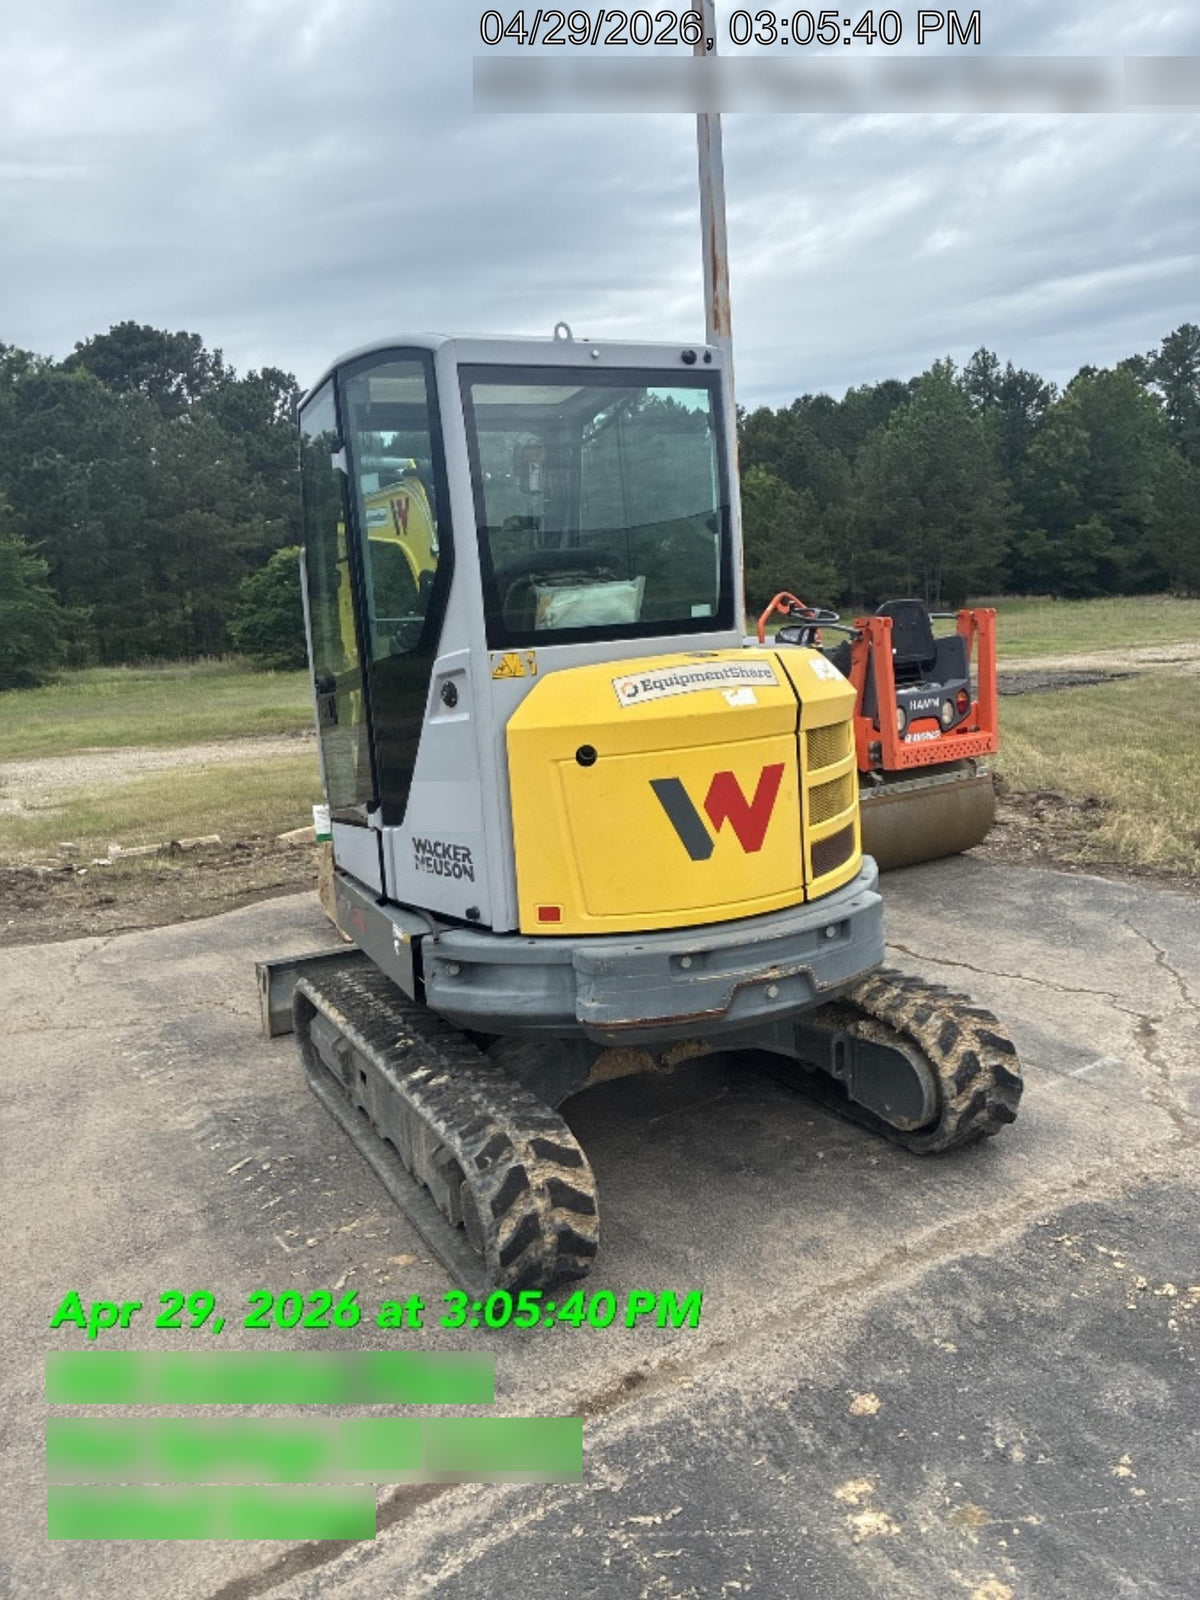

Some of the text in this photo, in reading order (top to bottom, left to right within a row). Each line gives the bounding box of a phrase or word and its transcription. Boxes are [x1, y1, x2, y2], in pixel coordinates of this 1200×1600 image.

[640, 667, 773, 692] EquipmentShare
[412, 837, 473, 864] WACKER
[415, 854, 475, 882] NEUSON
